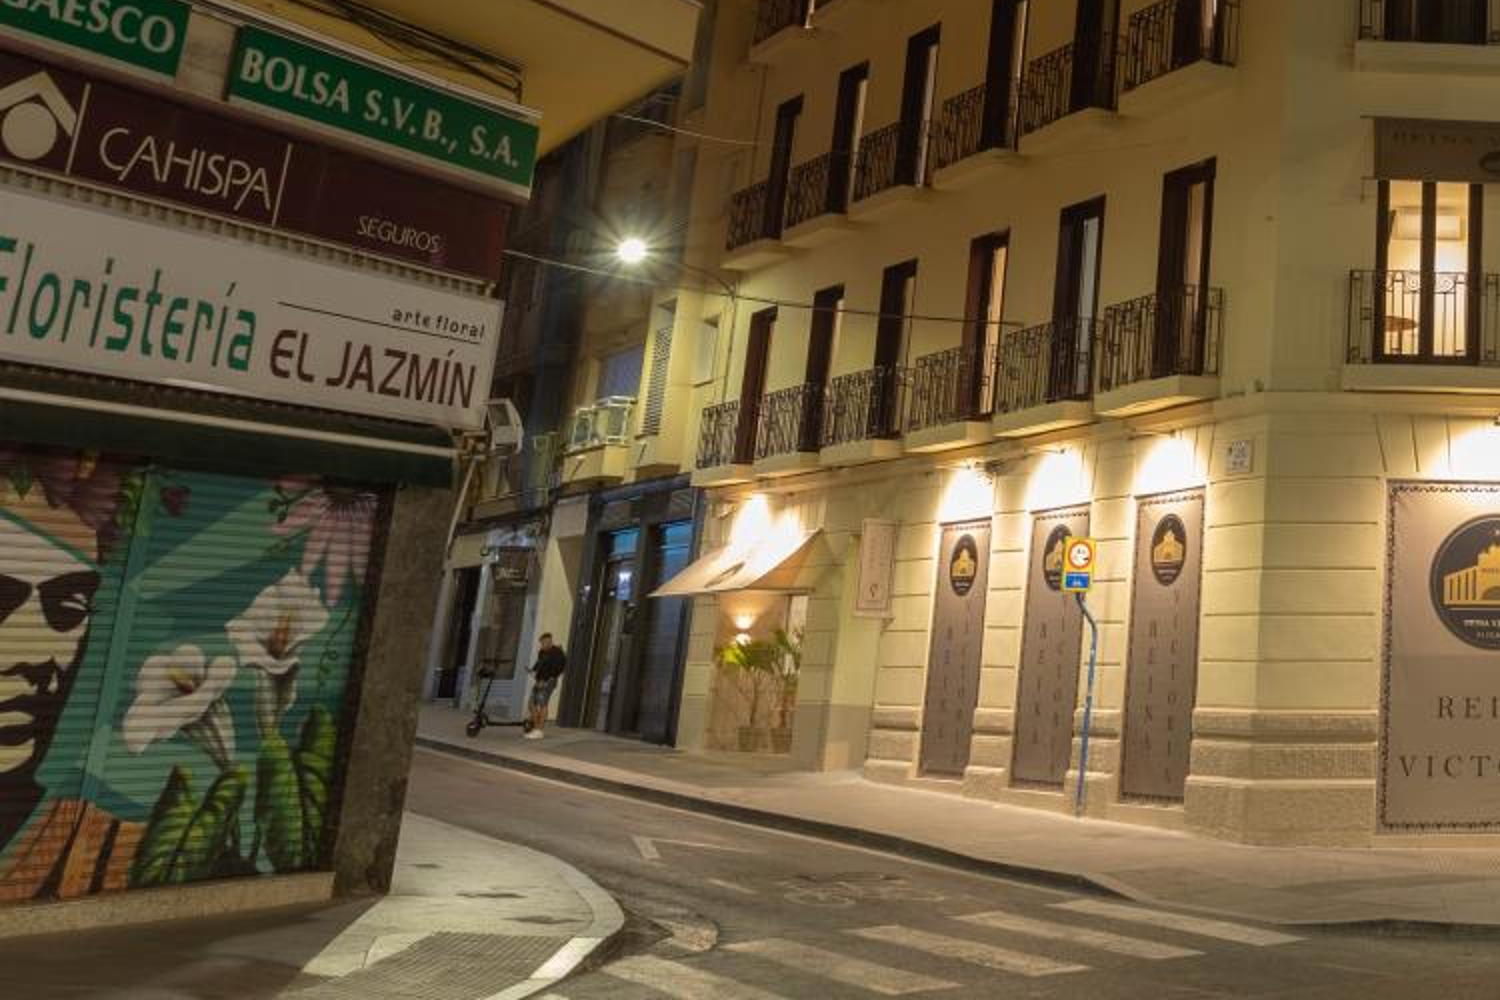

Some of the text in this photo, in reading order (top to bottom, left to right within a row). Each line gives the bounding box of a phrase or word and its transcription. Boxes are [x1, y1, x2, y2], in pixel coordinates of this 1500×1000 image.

[240, 47, 520, 169] BOLSA S.V.B., S.A.
[100, 127, 271, 211] CAHISPA
[357, 215, 442, 253] SEGUROS
[391, 308, 485, 338] arte floral
[269, 328, 476, 409] EL JAZMÍN
